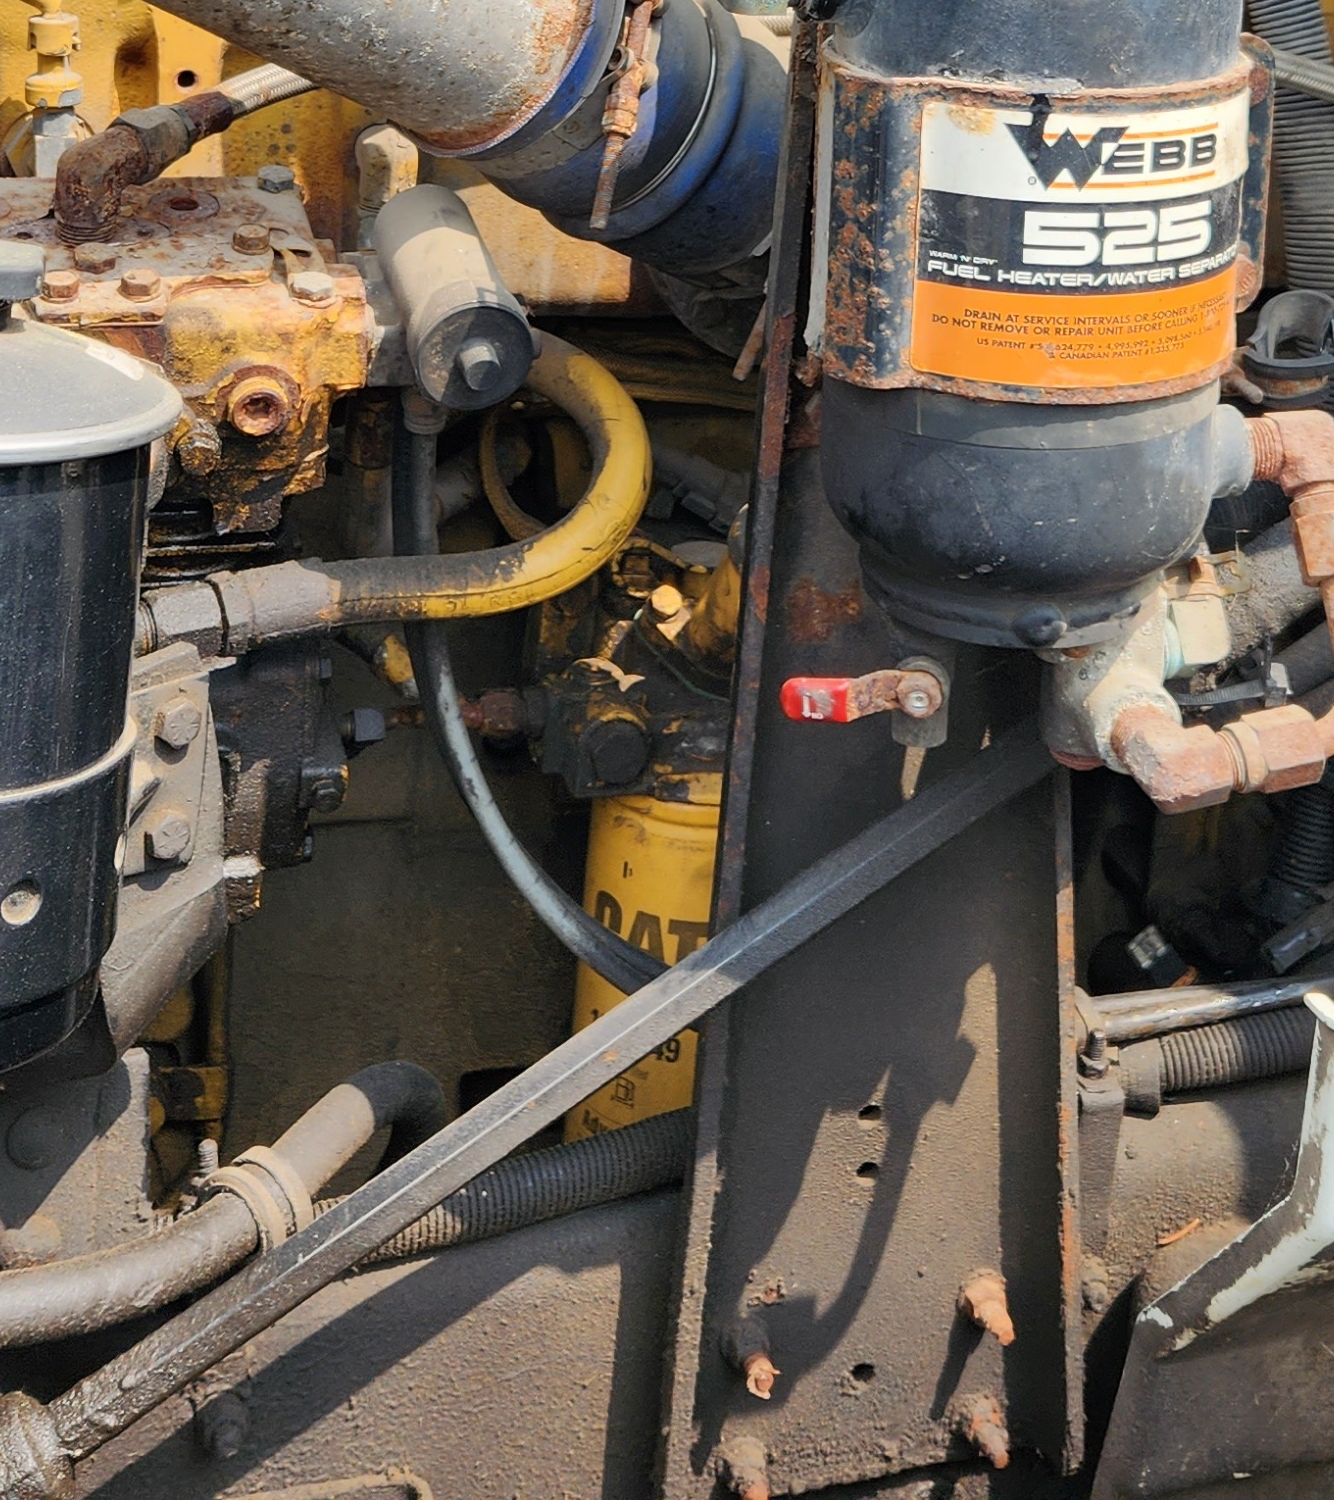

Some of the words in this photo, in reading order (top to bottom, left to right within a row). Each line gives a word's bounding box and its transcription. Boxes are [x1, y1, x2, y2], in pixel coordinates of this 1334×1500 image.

[1004, 122, 1217, 192] WEBB
[1022, 200, 1213, 267] 525
[928, 260, 991, 281] FUEL
[997, 266, 1176, 288] HEATER/WATER
[1179, 243, 1237, 279] SEPARATO
[932, 313, 949, 324] DO
[952, 317, 976, 330] NOT
[980, 322, 1029, 335] REMOVE
[1033, 326, 1050, 336] OR
[1054, 327, 1094, 336] REPAIR
[1098, 326, 1126, 336] UNIT
[1127, 322, 1162, 334] BEFORE
[1165, 314, 1198, 329] CALLING
[964, 308, 1001, 322] DRAIN
[1005, 315, 1019, 324] AT
[1023, 315, 1069, 326] SERVICE
[1074, 316, 1130, 326] INTERVALS
[1134, 314, 1149, 323] OR
[1152, 306, 1187, 320] SOONER
[977, 337, 989, 346] US
[992, 339, 1026, 350] PATENT
[1047, 342, 1094, 352] ,624,779
[1059, 351, 1109, 360] CANADIAN
[1112, 349, 1142, 358] PATENT
